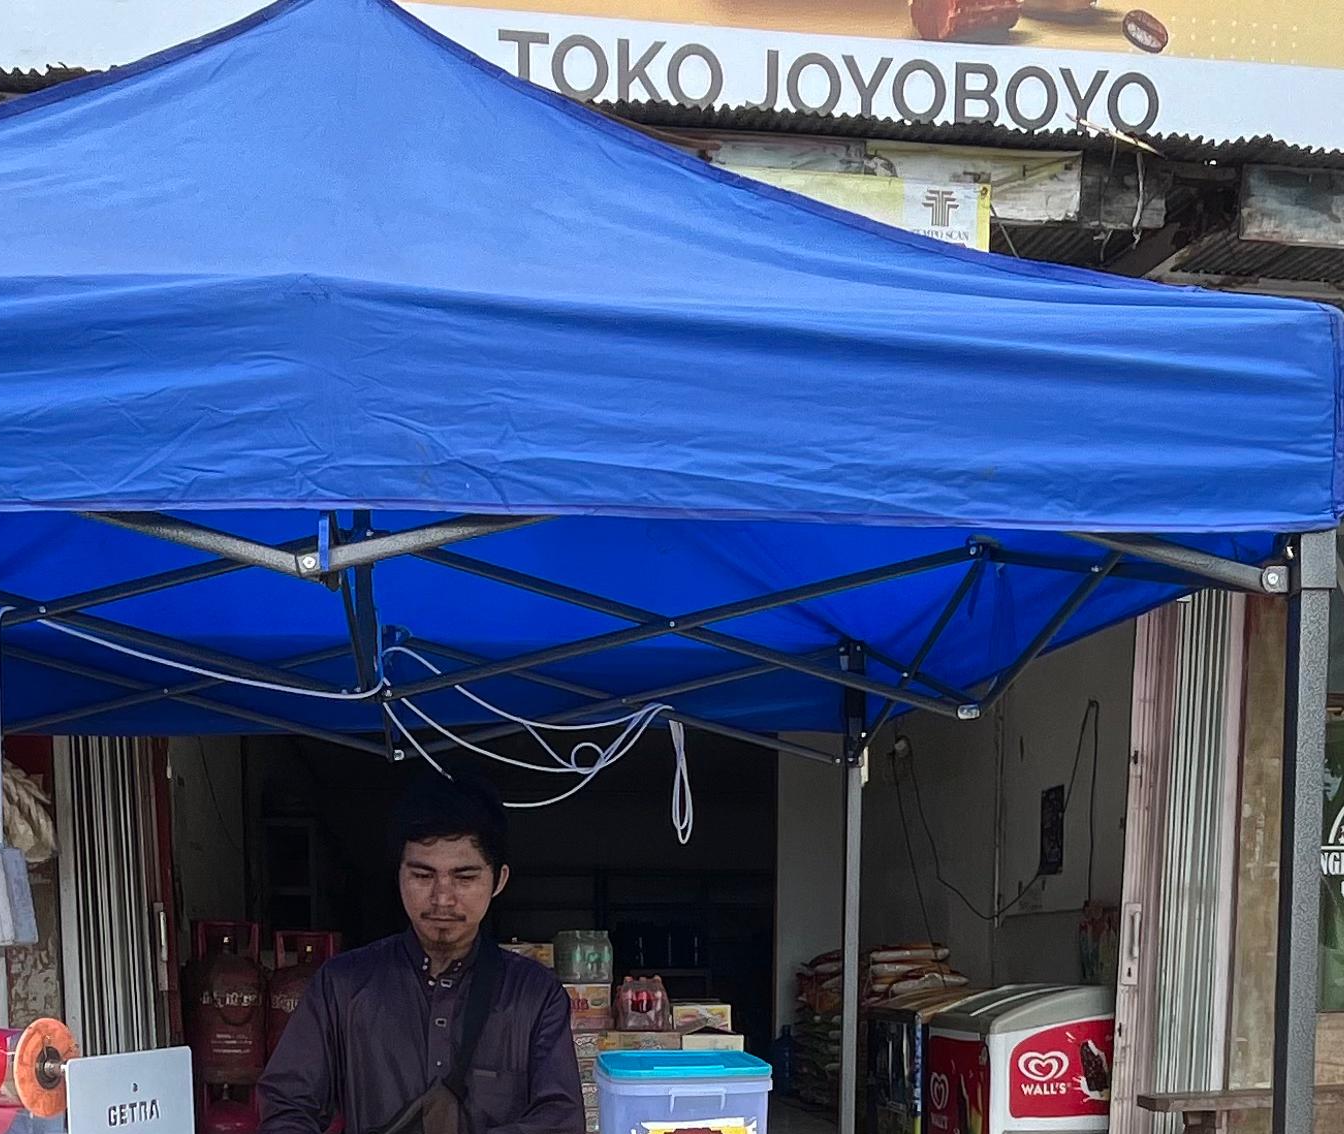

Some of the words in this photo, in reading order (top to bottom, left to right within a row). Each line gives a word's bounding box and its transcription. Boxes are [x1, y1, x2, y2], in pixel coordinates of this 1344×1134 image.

[498, 28, 723, 108] TOKO
[746, 49, 1159, 138] JOYOBOYO
[1021, 1082, 1068, 1096] WALL'S
